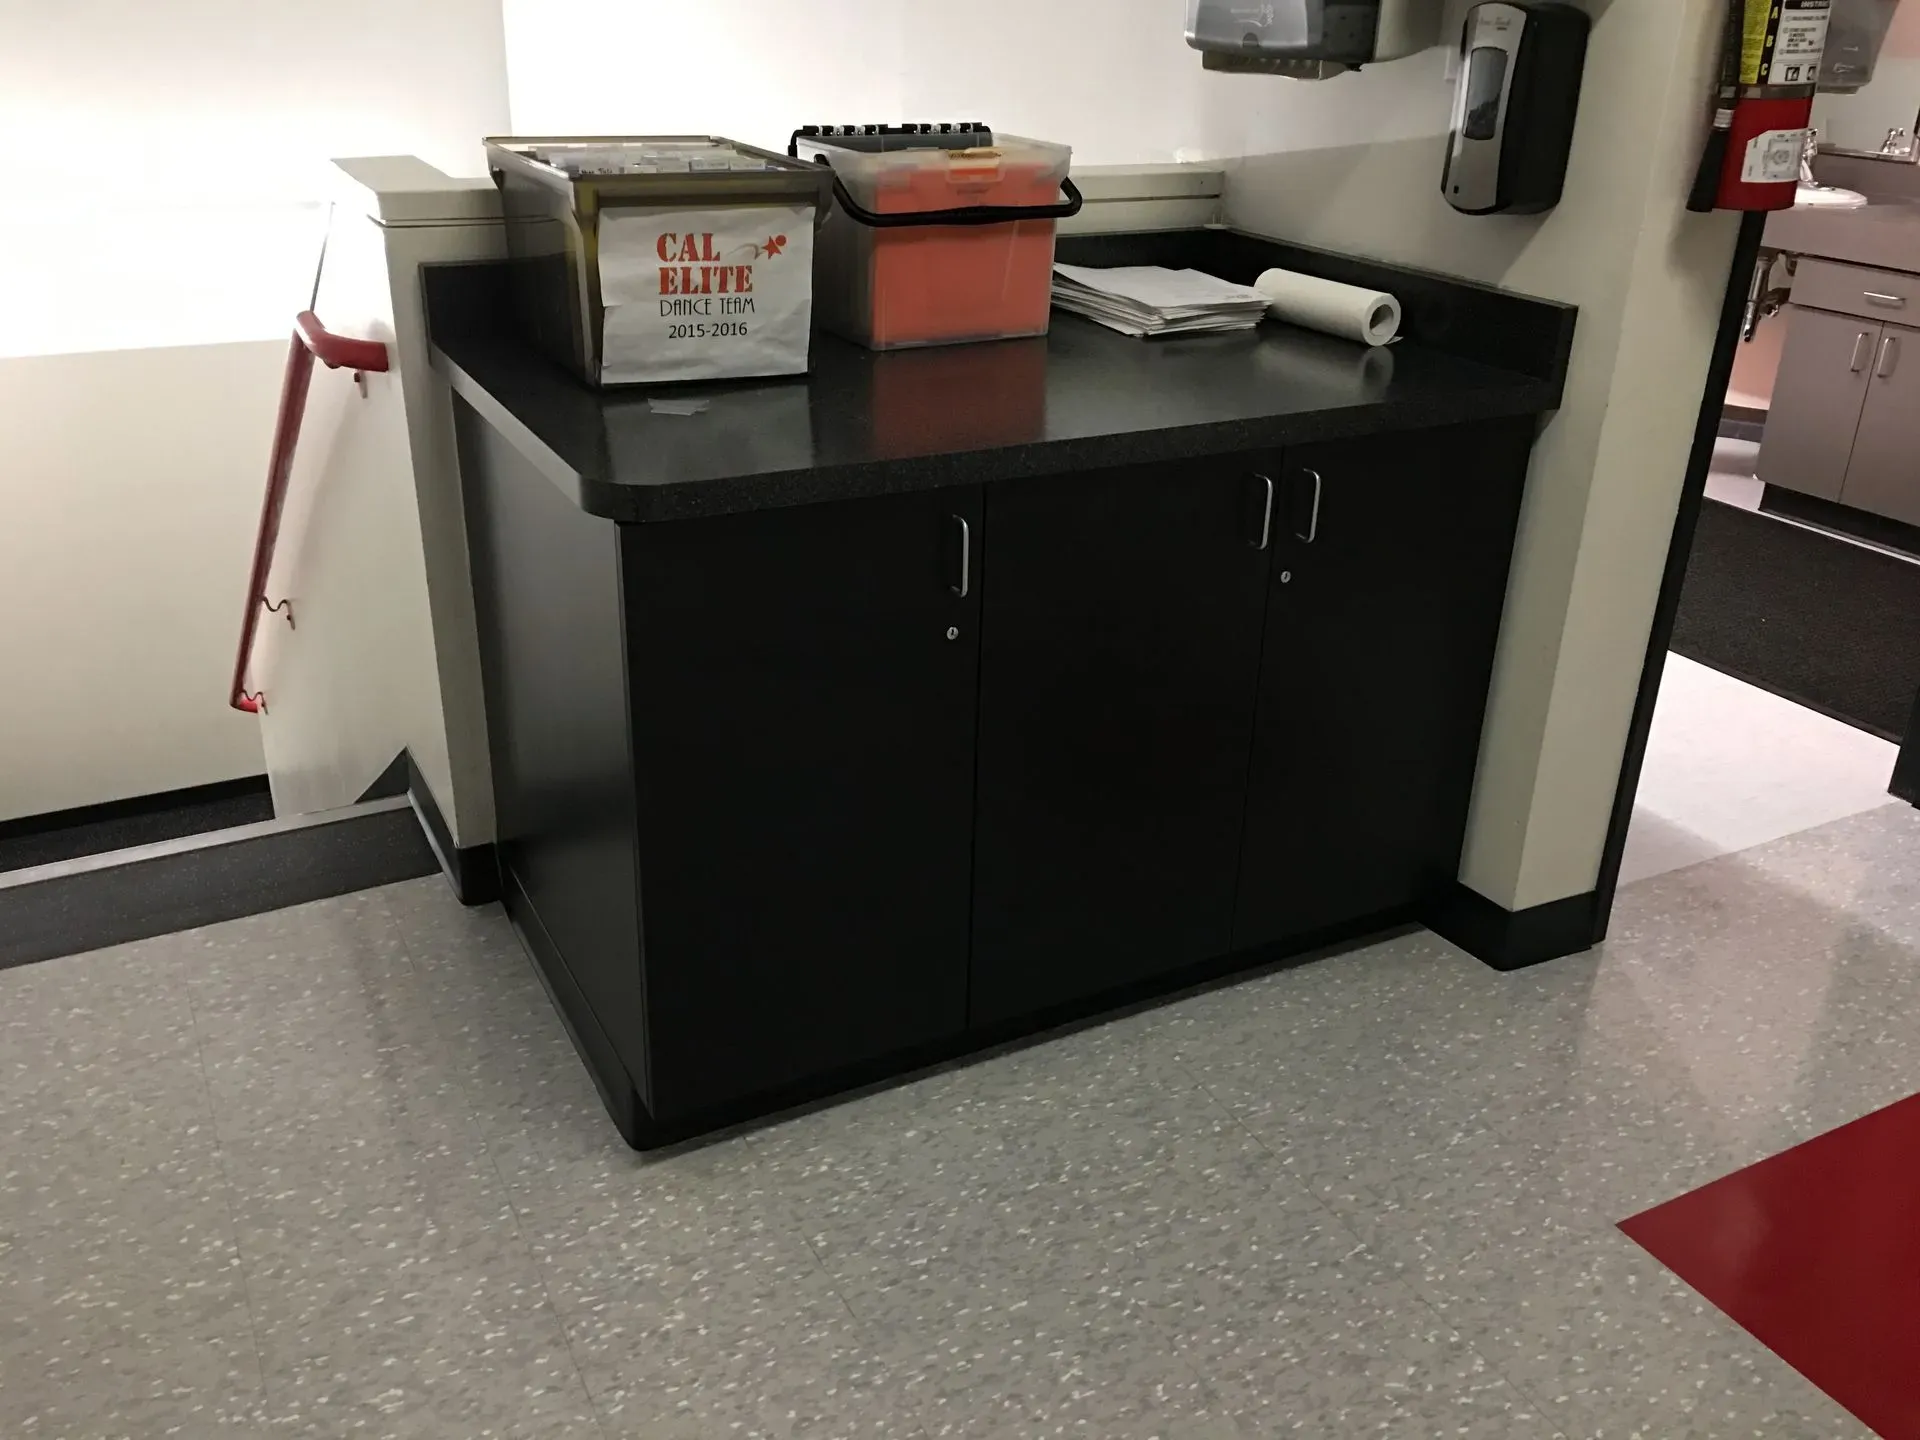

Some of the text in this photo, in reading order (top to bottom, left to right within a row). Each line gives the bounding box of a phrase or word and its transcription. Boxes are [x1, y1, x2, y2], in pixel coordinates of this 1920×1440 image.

[1771, 6, 1778, 19] A
[1766, 35, 1774, 47] B
[1761, 63, 1768, 76] C
[656, 232, 721, 262] CAL
[658, 264, 753, 295] ELITE
[660, 297, 755, 317] DANCE TEAM
[668, 322, 748, 339] 2015-2016
